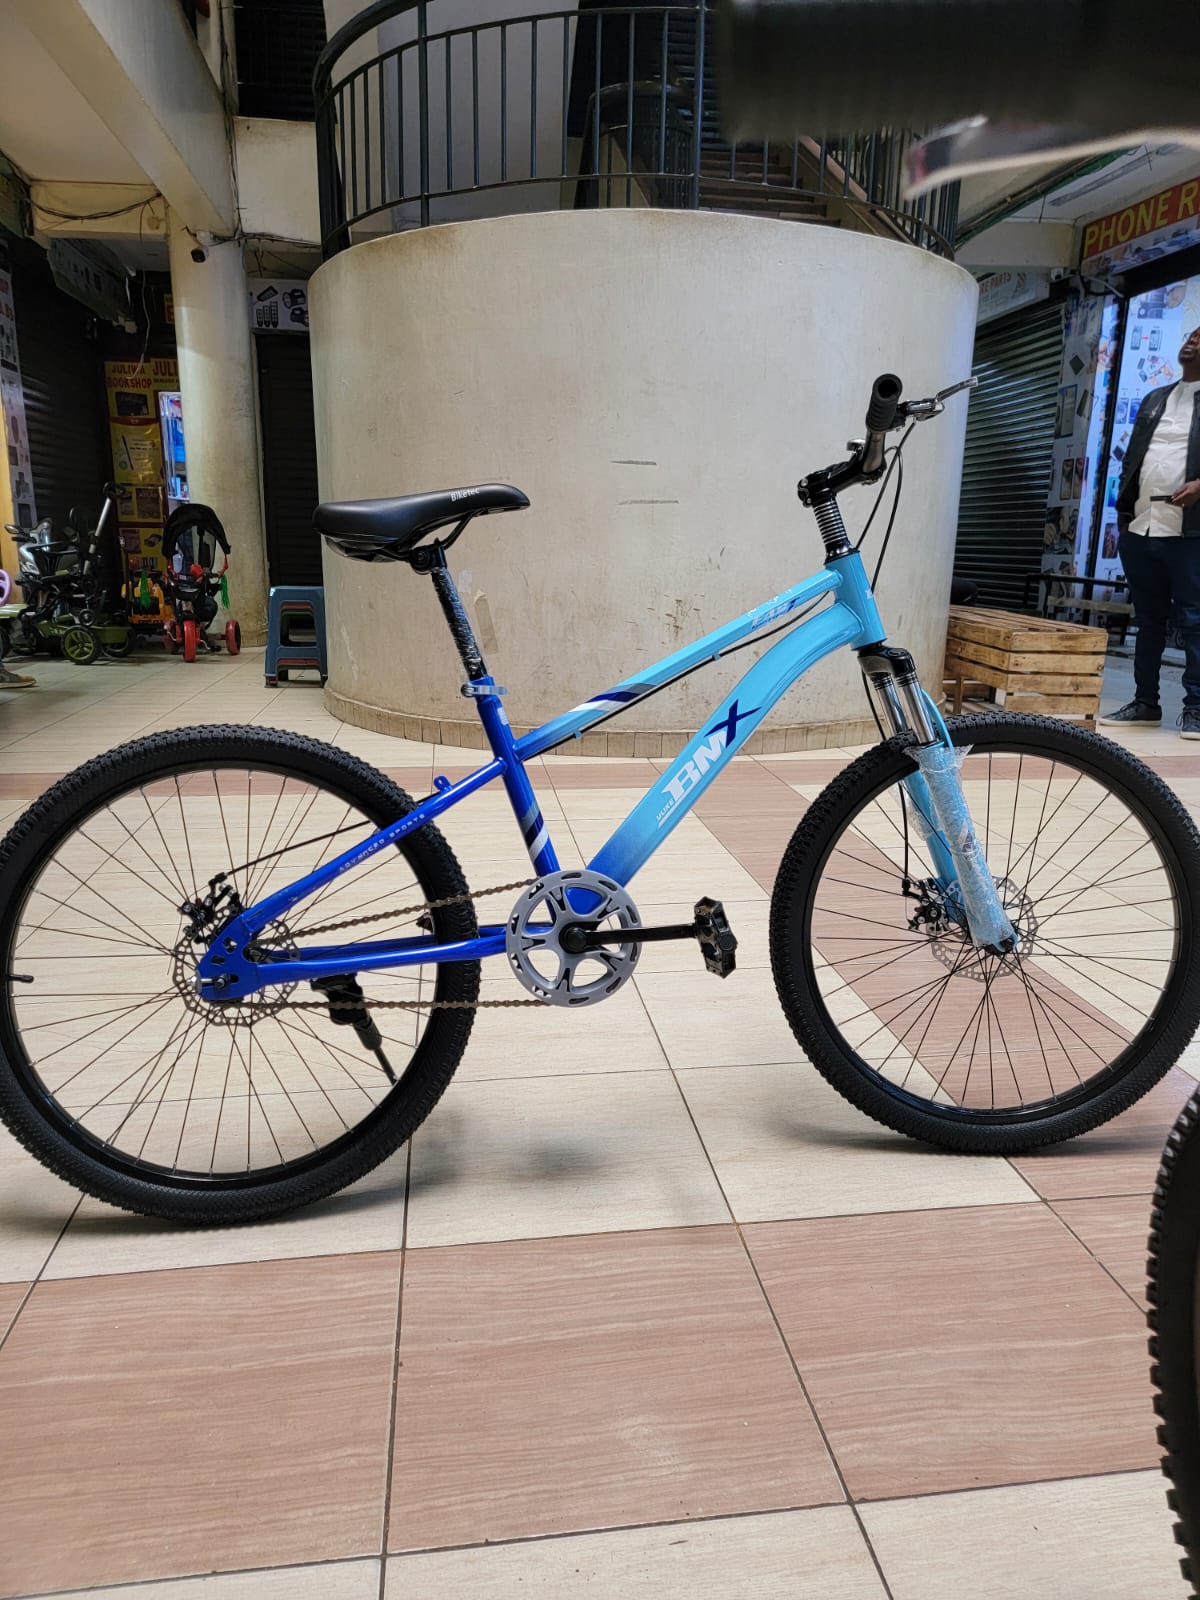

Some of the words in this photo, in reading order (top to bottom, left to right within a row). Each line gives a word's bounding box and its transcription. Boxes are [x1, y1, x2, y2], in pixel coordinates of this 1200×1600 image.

[1083, 191, 1172, 257] PHONE
[1177, 180, 1200, 219] R
[661, 699, 762, 801] BMX
[389, 813, 425, 838] SPORTS
